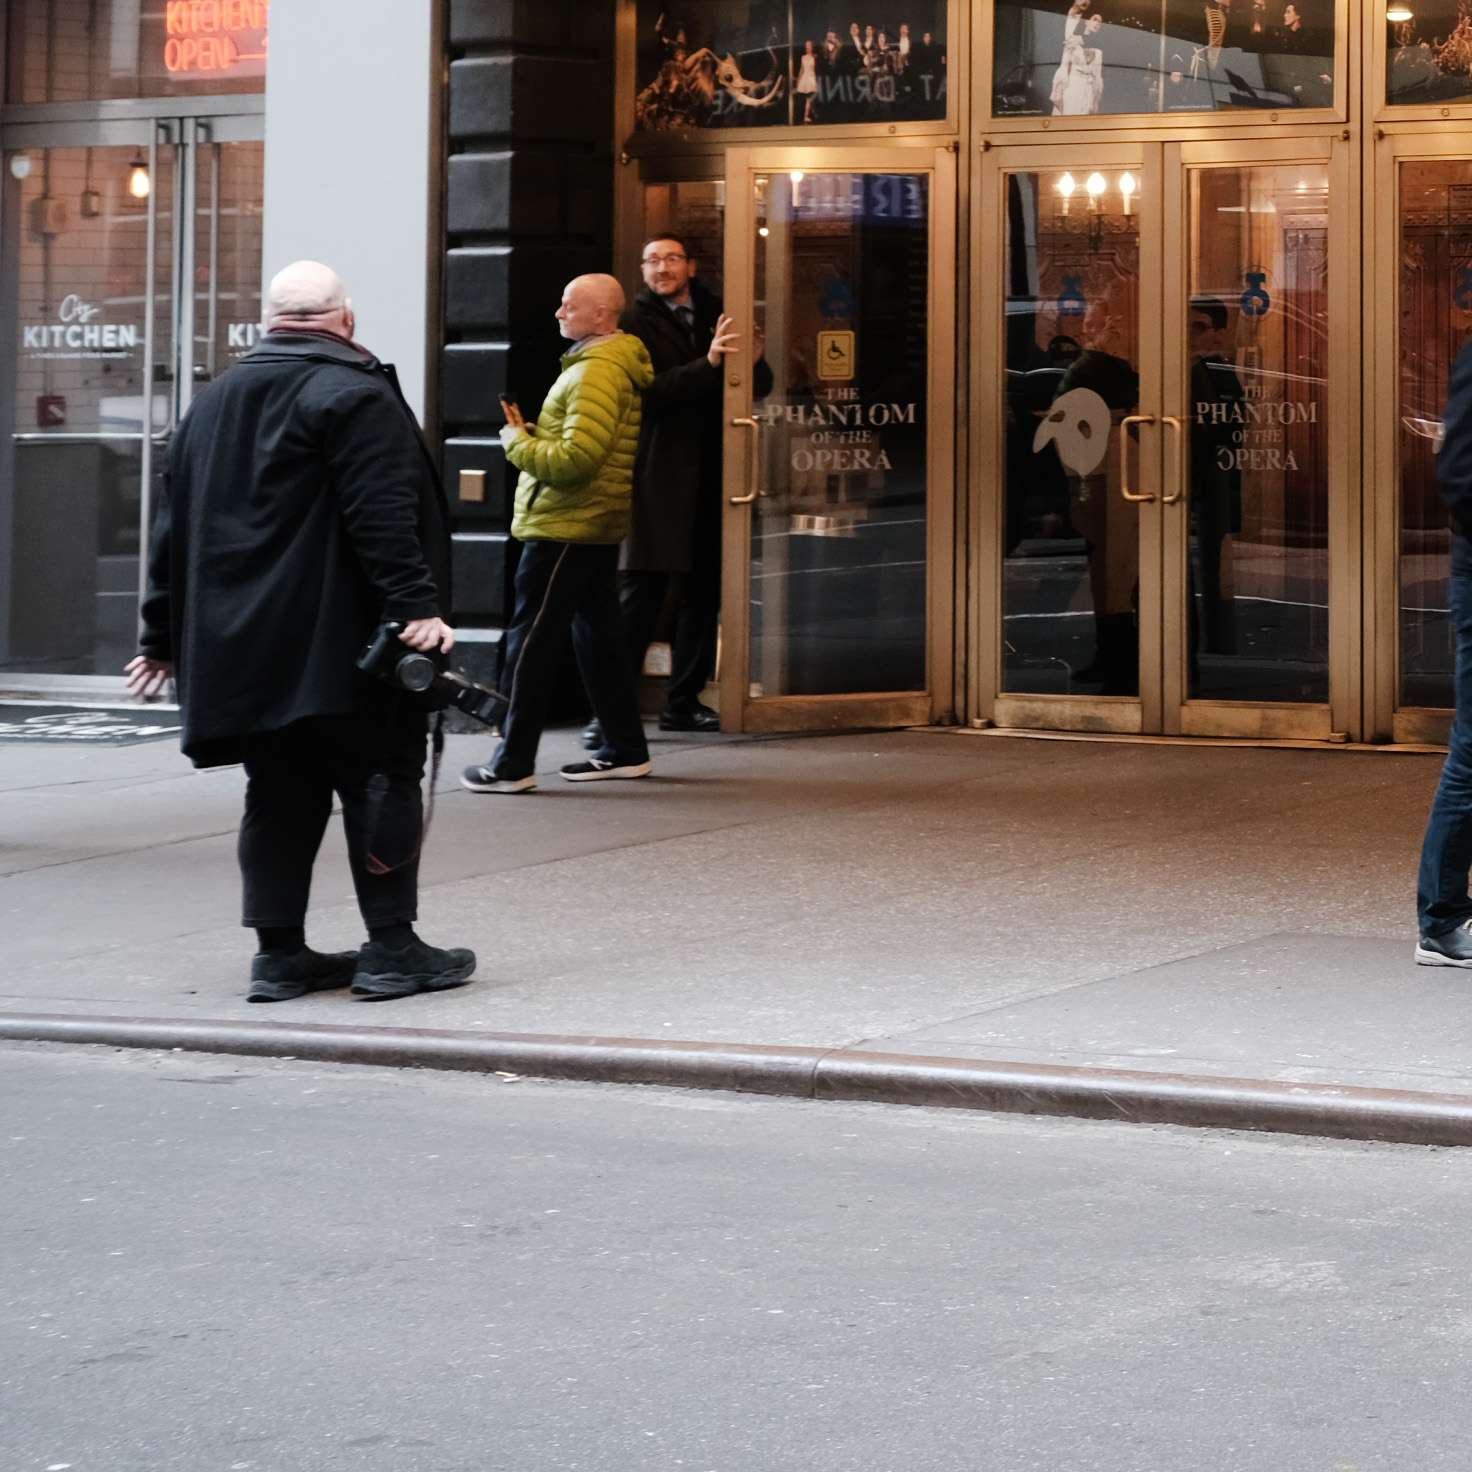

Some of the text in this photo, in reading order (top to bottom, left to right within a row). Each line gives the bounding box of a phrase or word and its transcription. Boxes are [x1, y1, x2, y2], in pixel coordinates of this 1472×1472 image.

[164, 37, 231, 72] OPEN
[24, 324, 135, 348] KITCHEN
[824, 388, 860, 400] THE
[1243, 386, 1271, 400] THE
[766, 403, 918, 427] PHANTOM
[1196, 401, 1319, 425] PHANTOM
[811, 430, 873, 444] OF THE
[1232, 429, 1283, 443] OF THE
[791, 448, 893, 472] OPERA
[1216, 445, 1299, 471] OPERA
